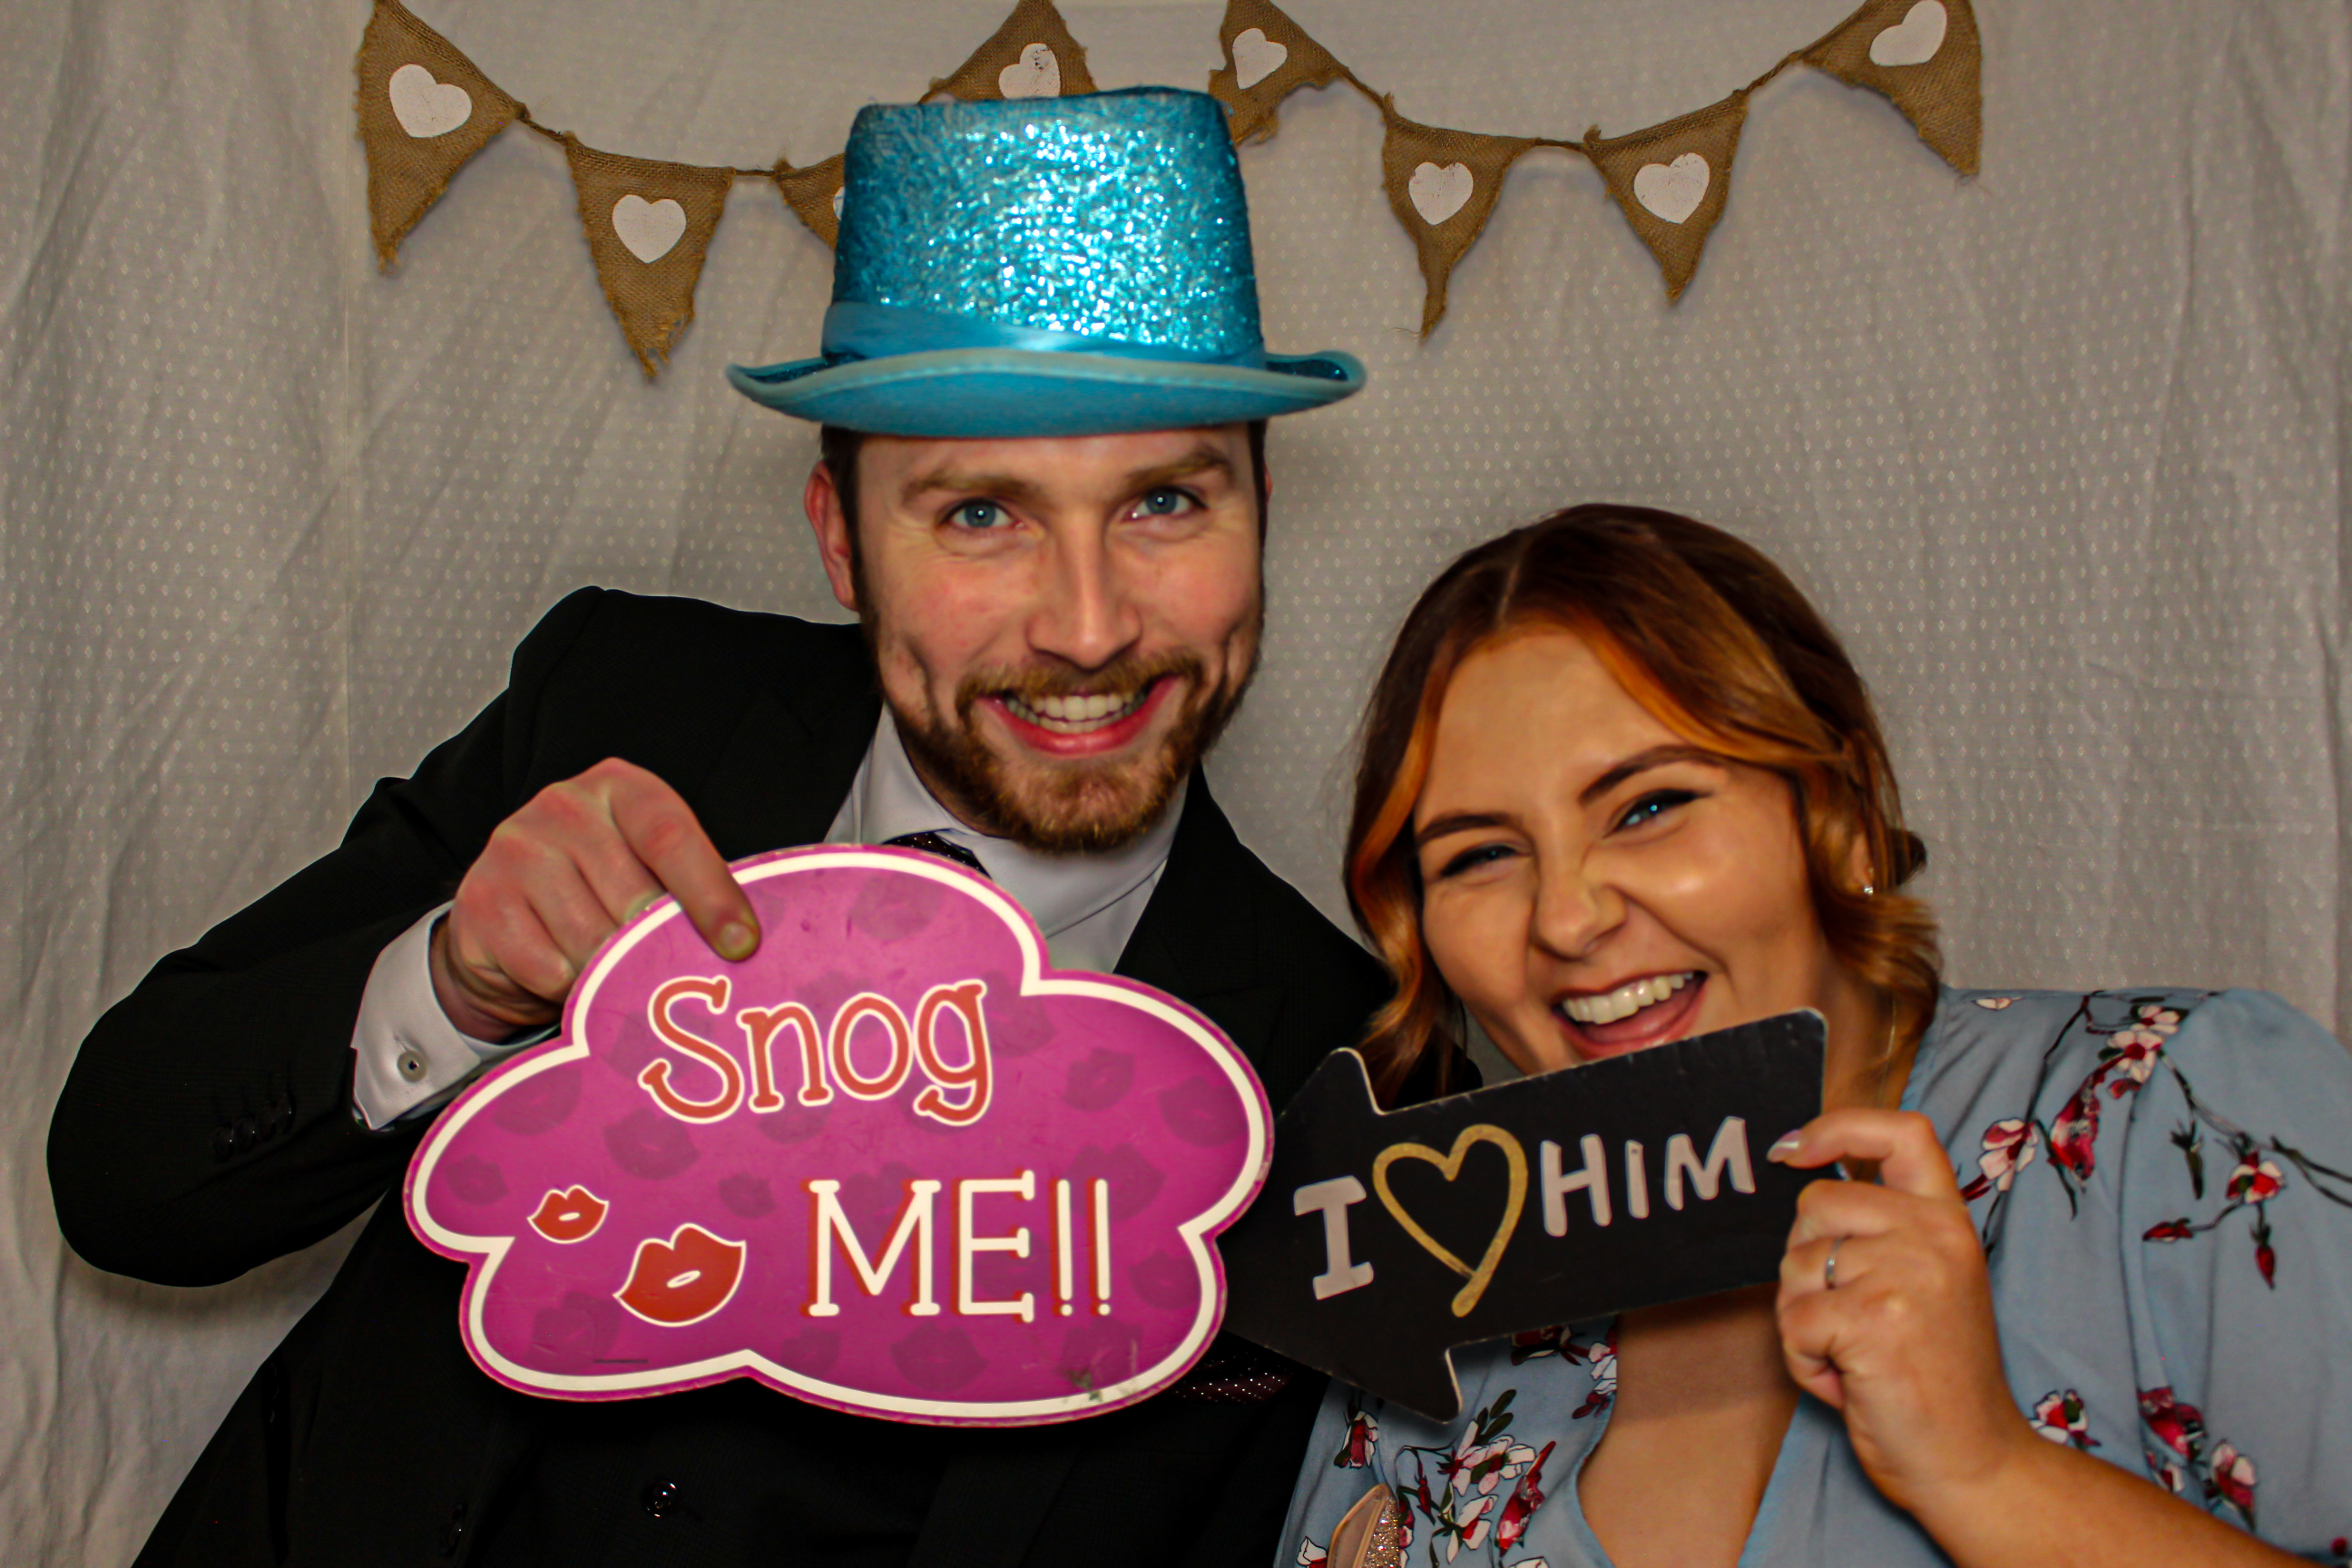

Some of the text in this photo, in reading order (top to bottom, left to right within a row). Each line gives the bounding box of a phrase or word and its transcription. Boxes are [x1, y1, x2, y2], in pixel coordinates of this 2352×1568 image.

[638, 975, 994, 1127] Snog
[803, 1170, 1112, 1323] ME!!
[1292, 1115, 1756, 1300] I HIM
